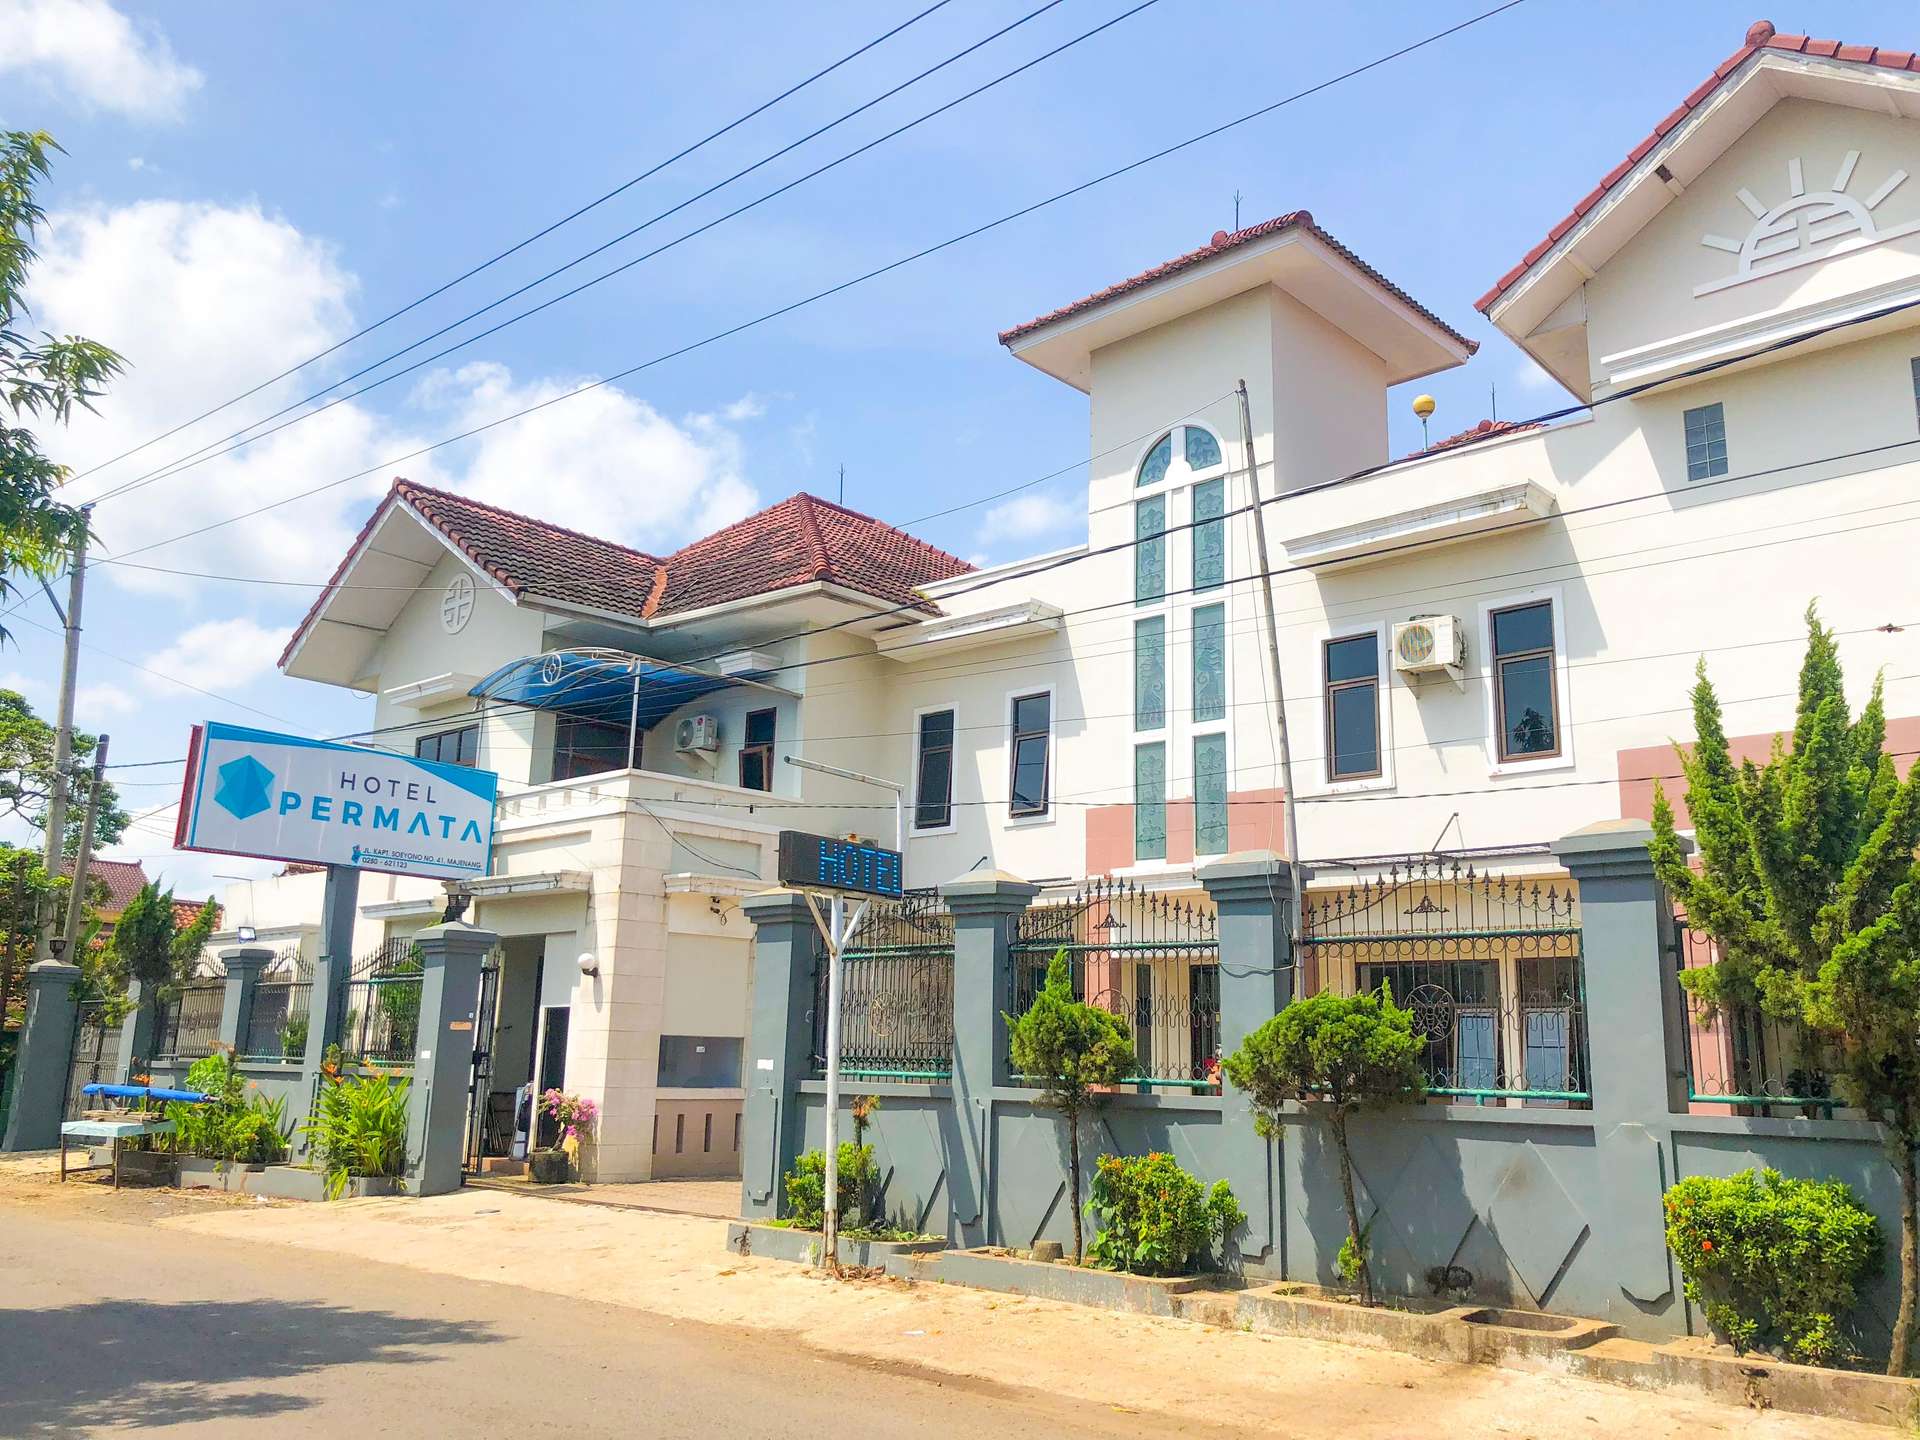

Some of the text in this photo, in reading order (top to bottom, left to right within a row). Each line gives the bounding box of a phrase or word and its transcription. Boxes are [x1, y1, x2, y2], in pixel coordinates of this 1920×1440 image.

[340, 771, 437, 804] HOTEL
[279, 791, 482, 844] PERMATA
[819, 840, 902, 893] HOTEL
